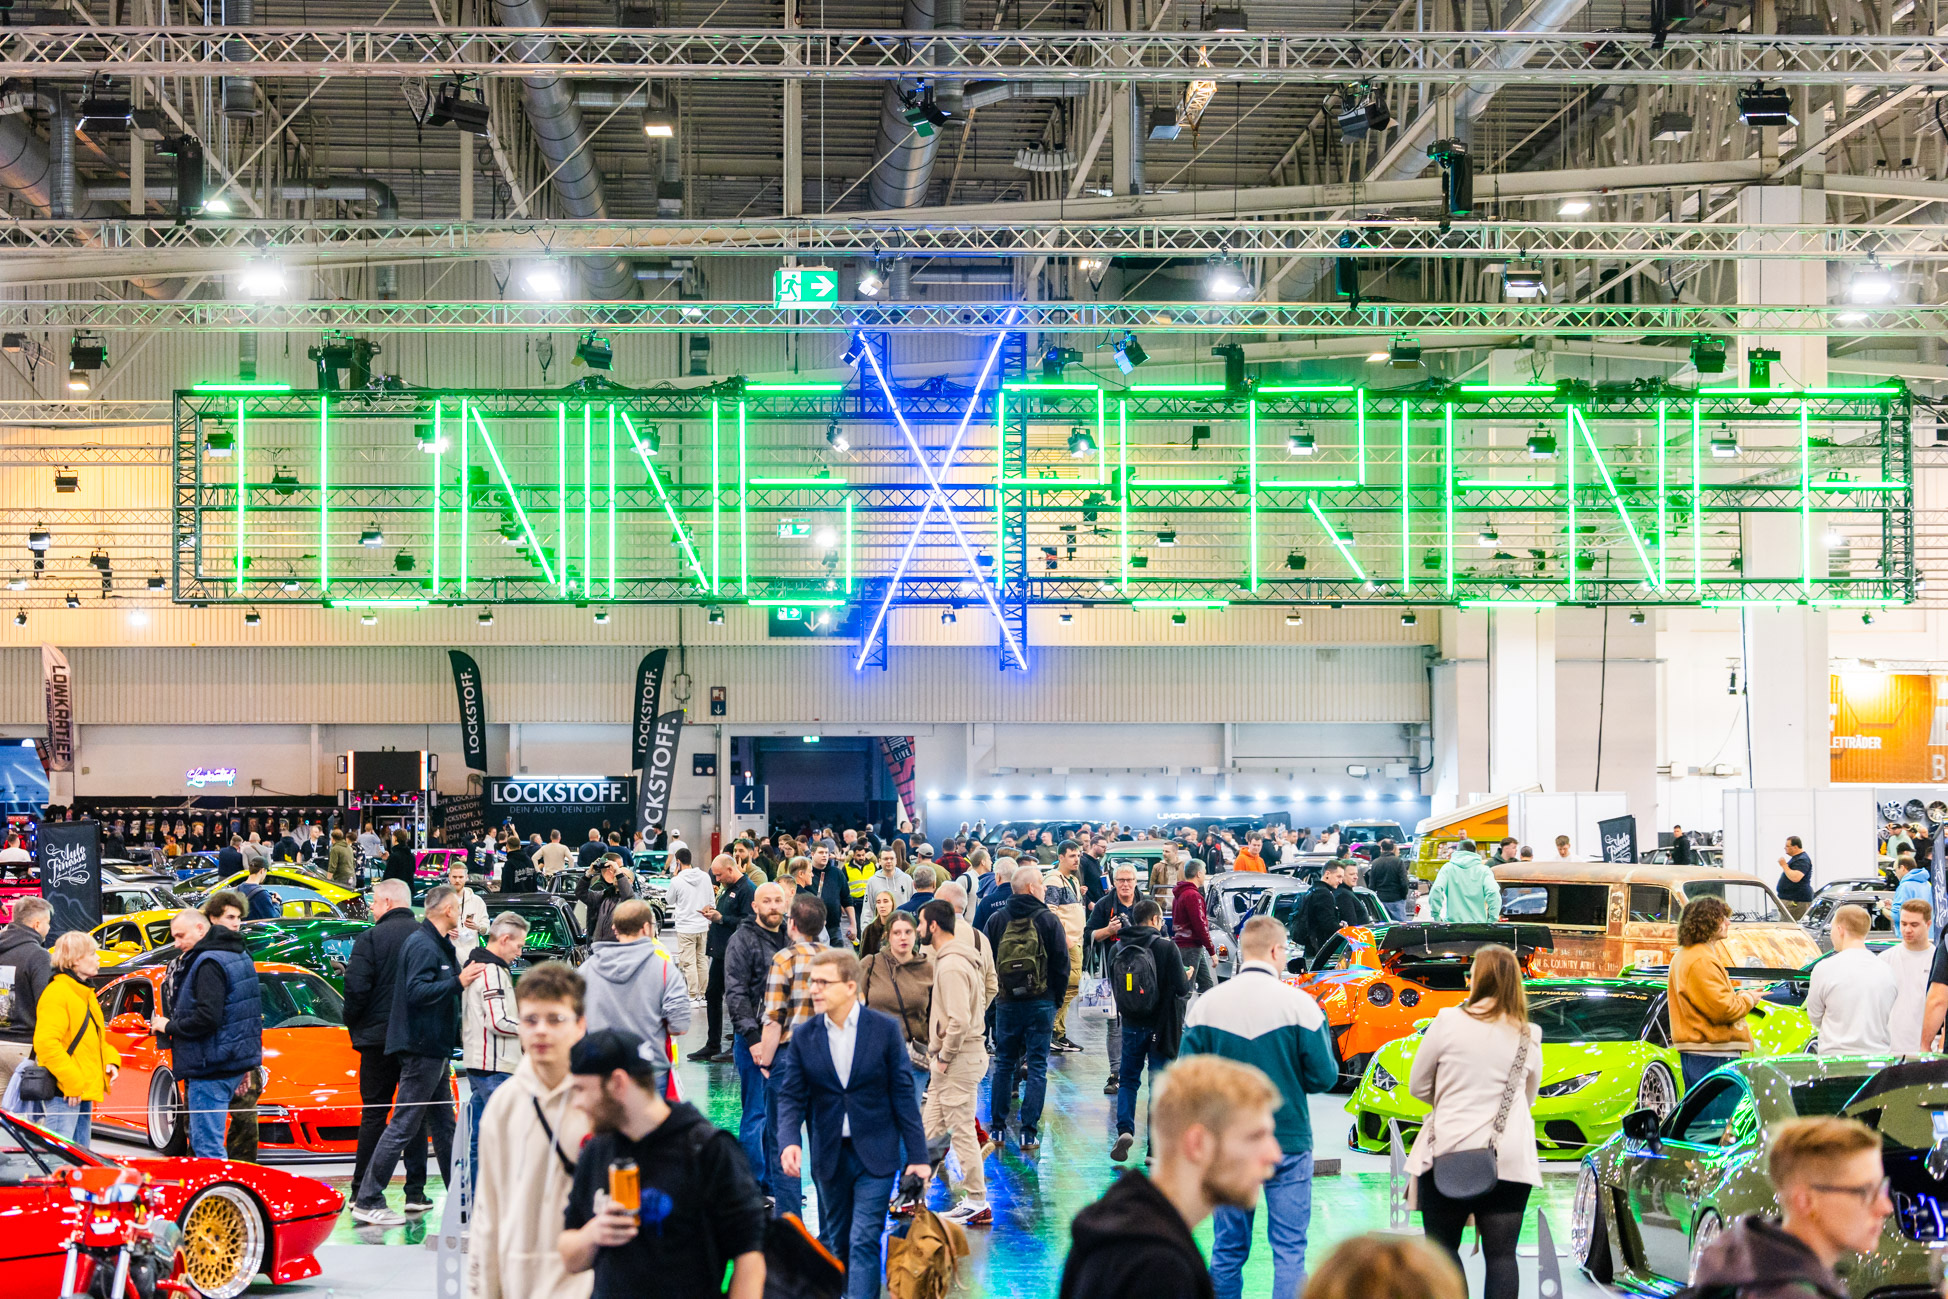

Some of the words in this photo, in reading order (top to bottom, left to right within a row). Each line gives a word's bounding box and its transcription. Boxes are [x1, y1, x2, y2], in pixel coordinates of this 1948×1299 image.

[52, 665, 71, 762] LOWKRATIEF
[461, 667, 479, 754] LOCKSTOFF.
[894, 748, 911, 761] LIVE
[642, 718, 677, 845] OCKSTOFF.
[493, 783, 627, 803] LOCKSTOFF.
[741, 789, 756, 811] 4
[509, 806, 531, 814] DEIN
[533, 806, 557, 814] AUTO
[561, 805, 582, 814] DEIN
[585, 805, 606, 813] DUFT
[1550, 958, 1578, 970] COUNTRY
